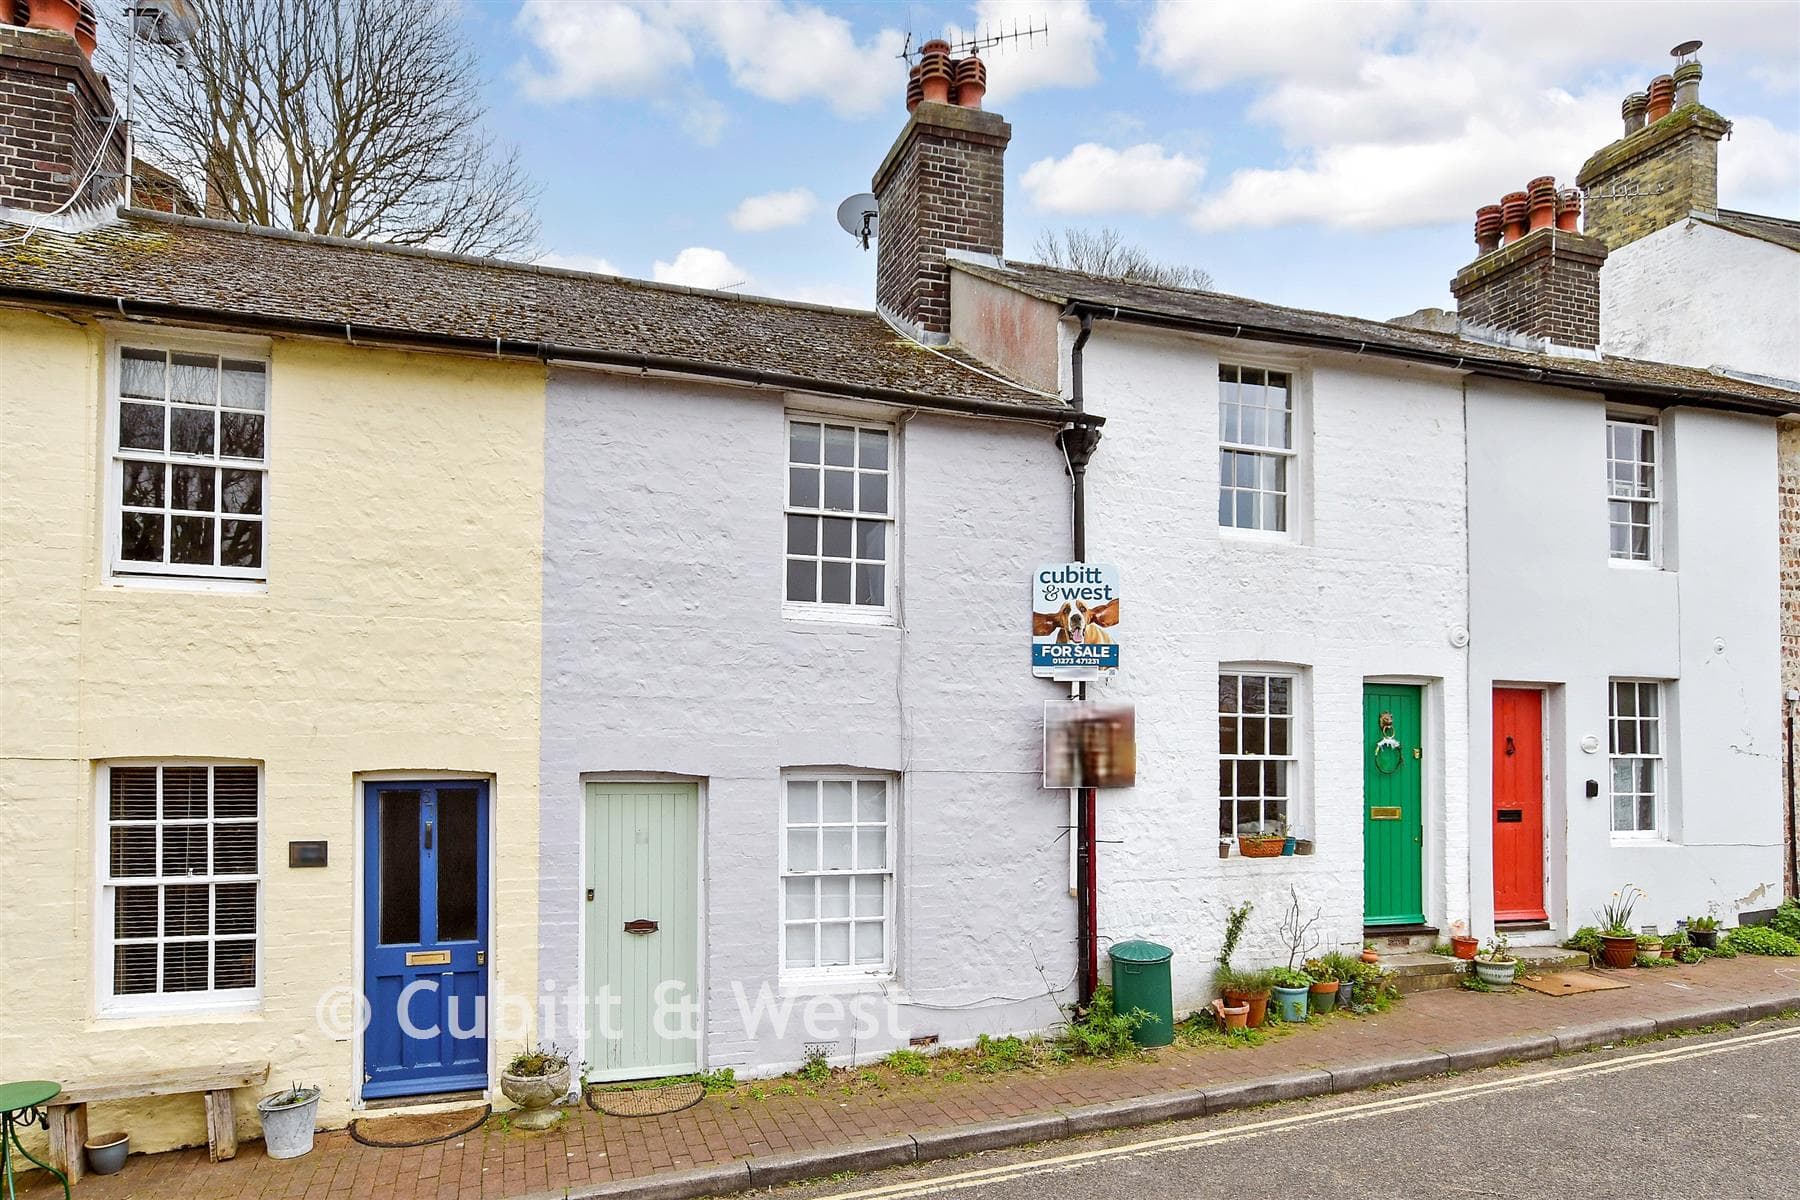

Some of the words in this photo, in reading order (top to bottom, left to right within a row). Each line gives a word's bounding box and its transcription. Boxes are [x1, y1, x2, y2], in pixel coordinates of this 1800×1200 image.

[1039, 565, 1103, 584] cubitt
[1041, 645, 1072, 657] FOR
[1074, 645, 1110, 657] SALE
[1052, 657, 1074, 665] 01273
[1075, 657, 1100, 665] 471231
